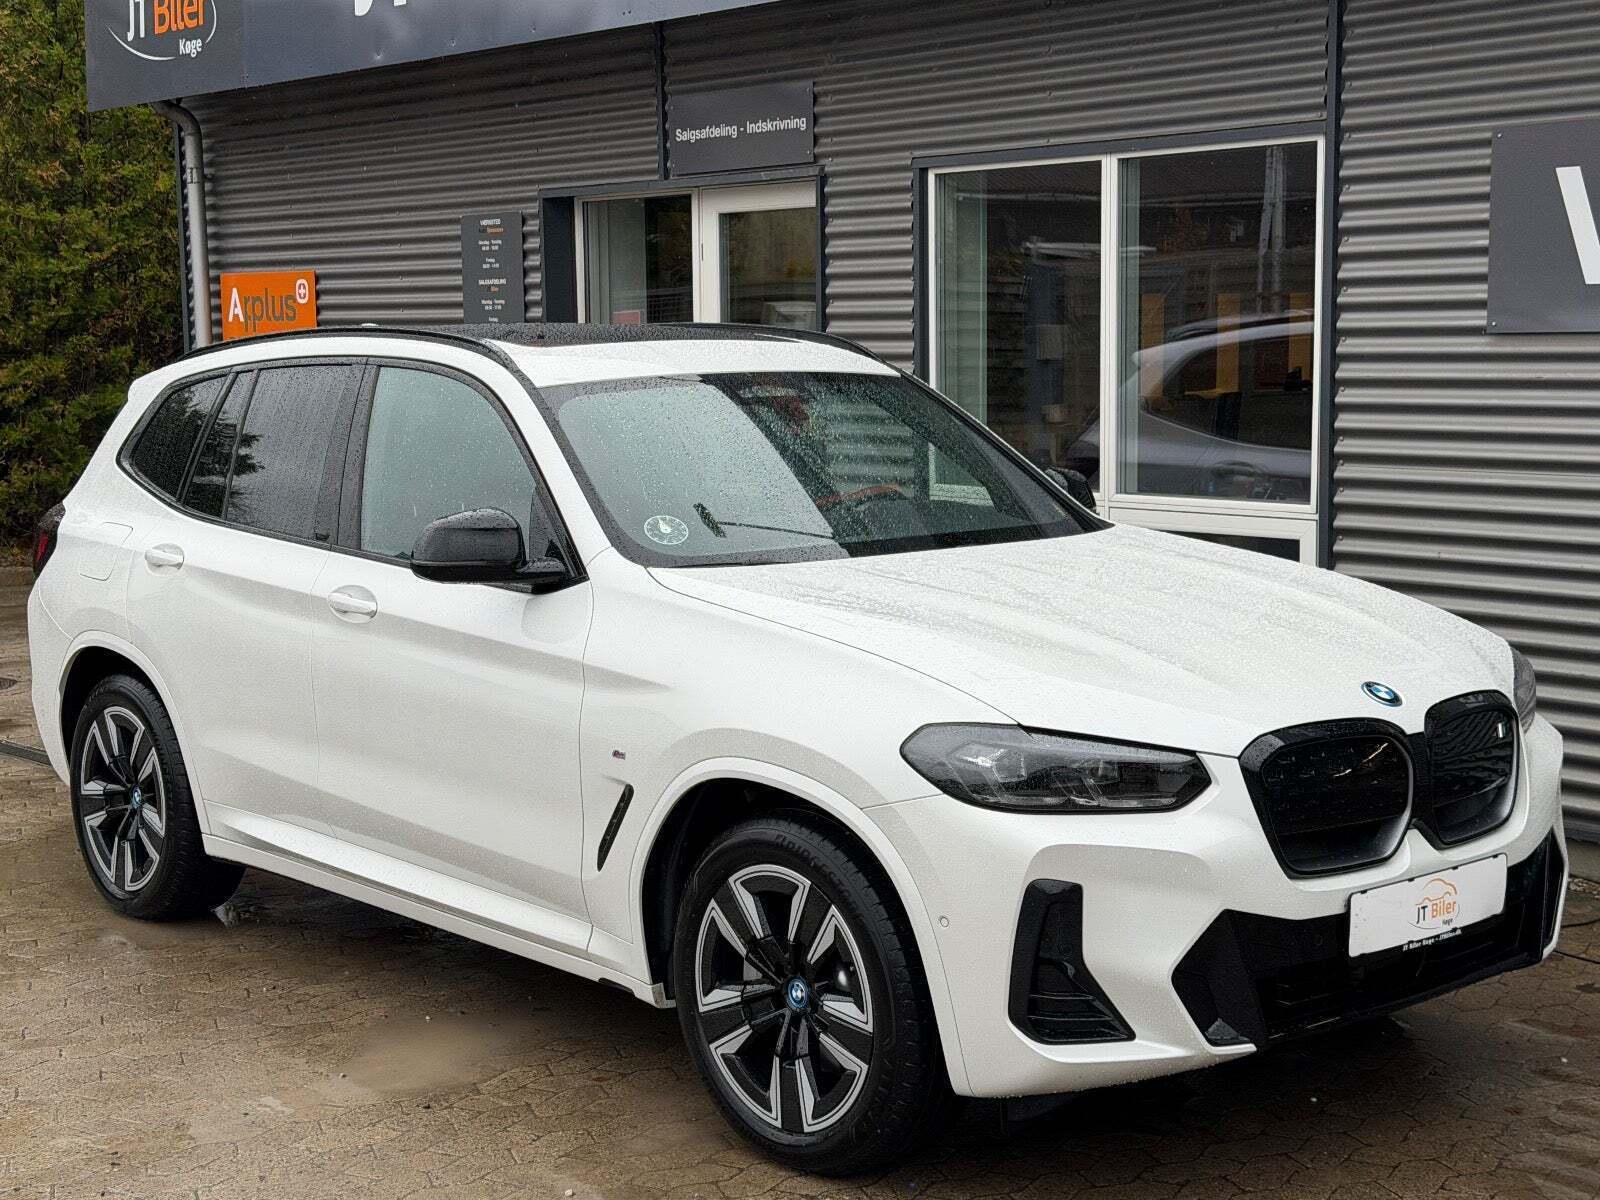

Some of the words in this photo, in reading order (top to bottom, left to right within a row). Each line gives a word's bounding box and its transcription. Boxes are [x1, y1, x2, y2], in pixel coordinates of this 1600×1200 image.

[179, 38, 203, 58] Køge
[675, 123, 738, 143] Salgsafdeling
[746, 115, 807, 135] Indskrivning
[1416, 905, 1428, 925] JT
[1431, 900, 1457, 919] Biler
